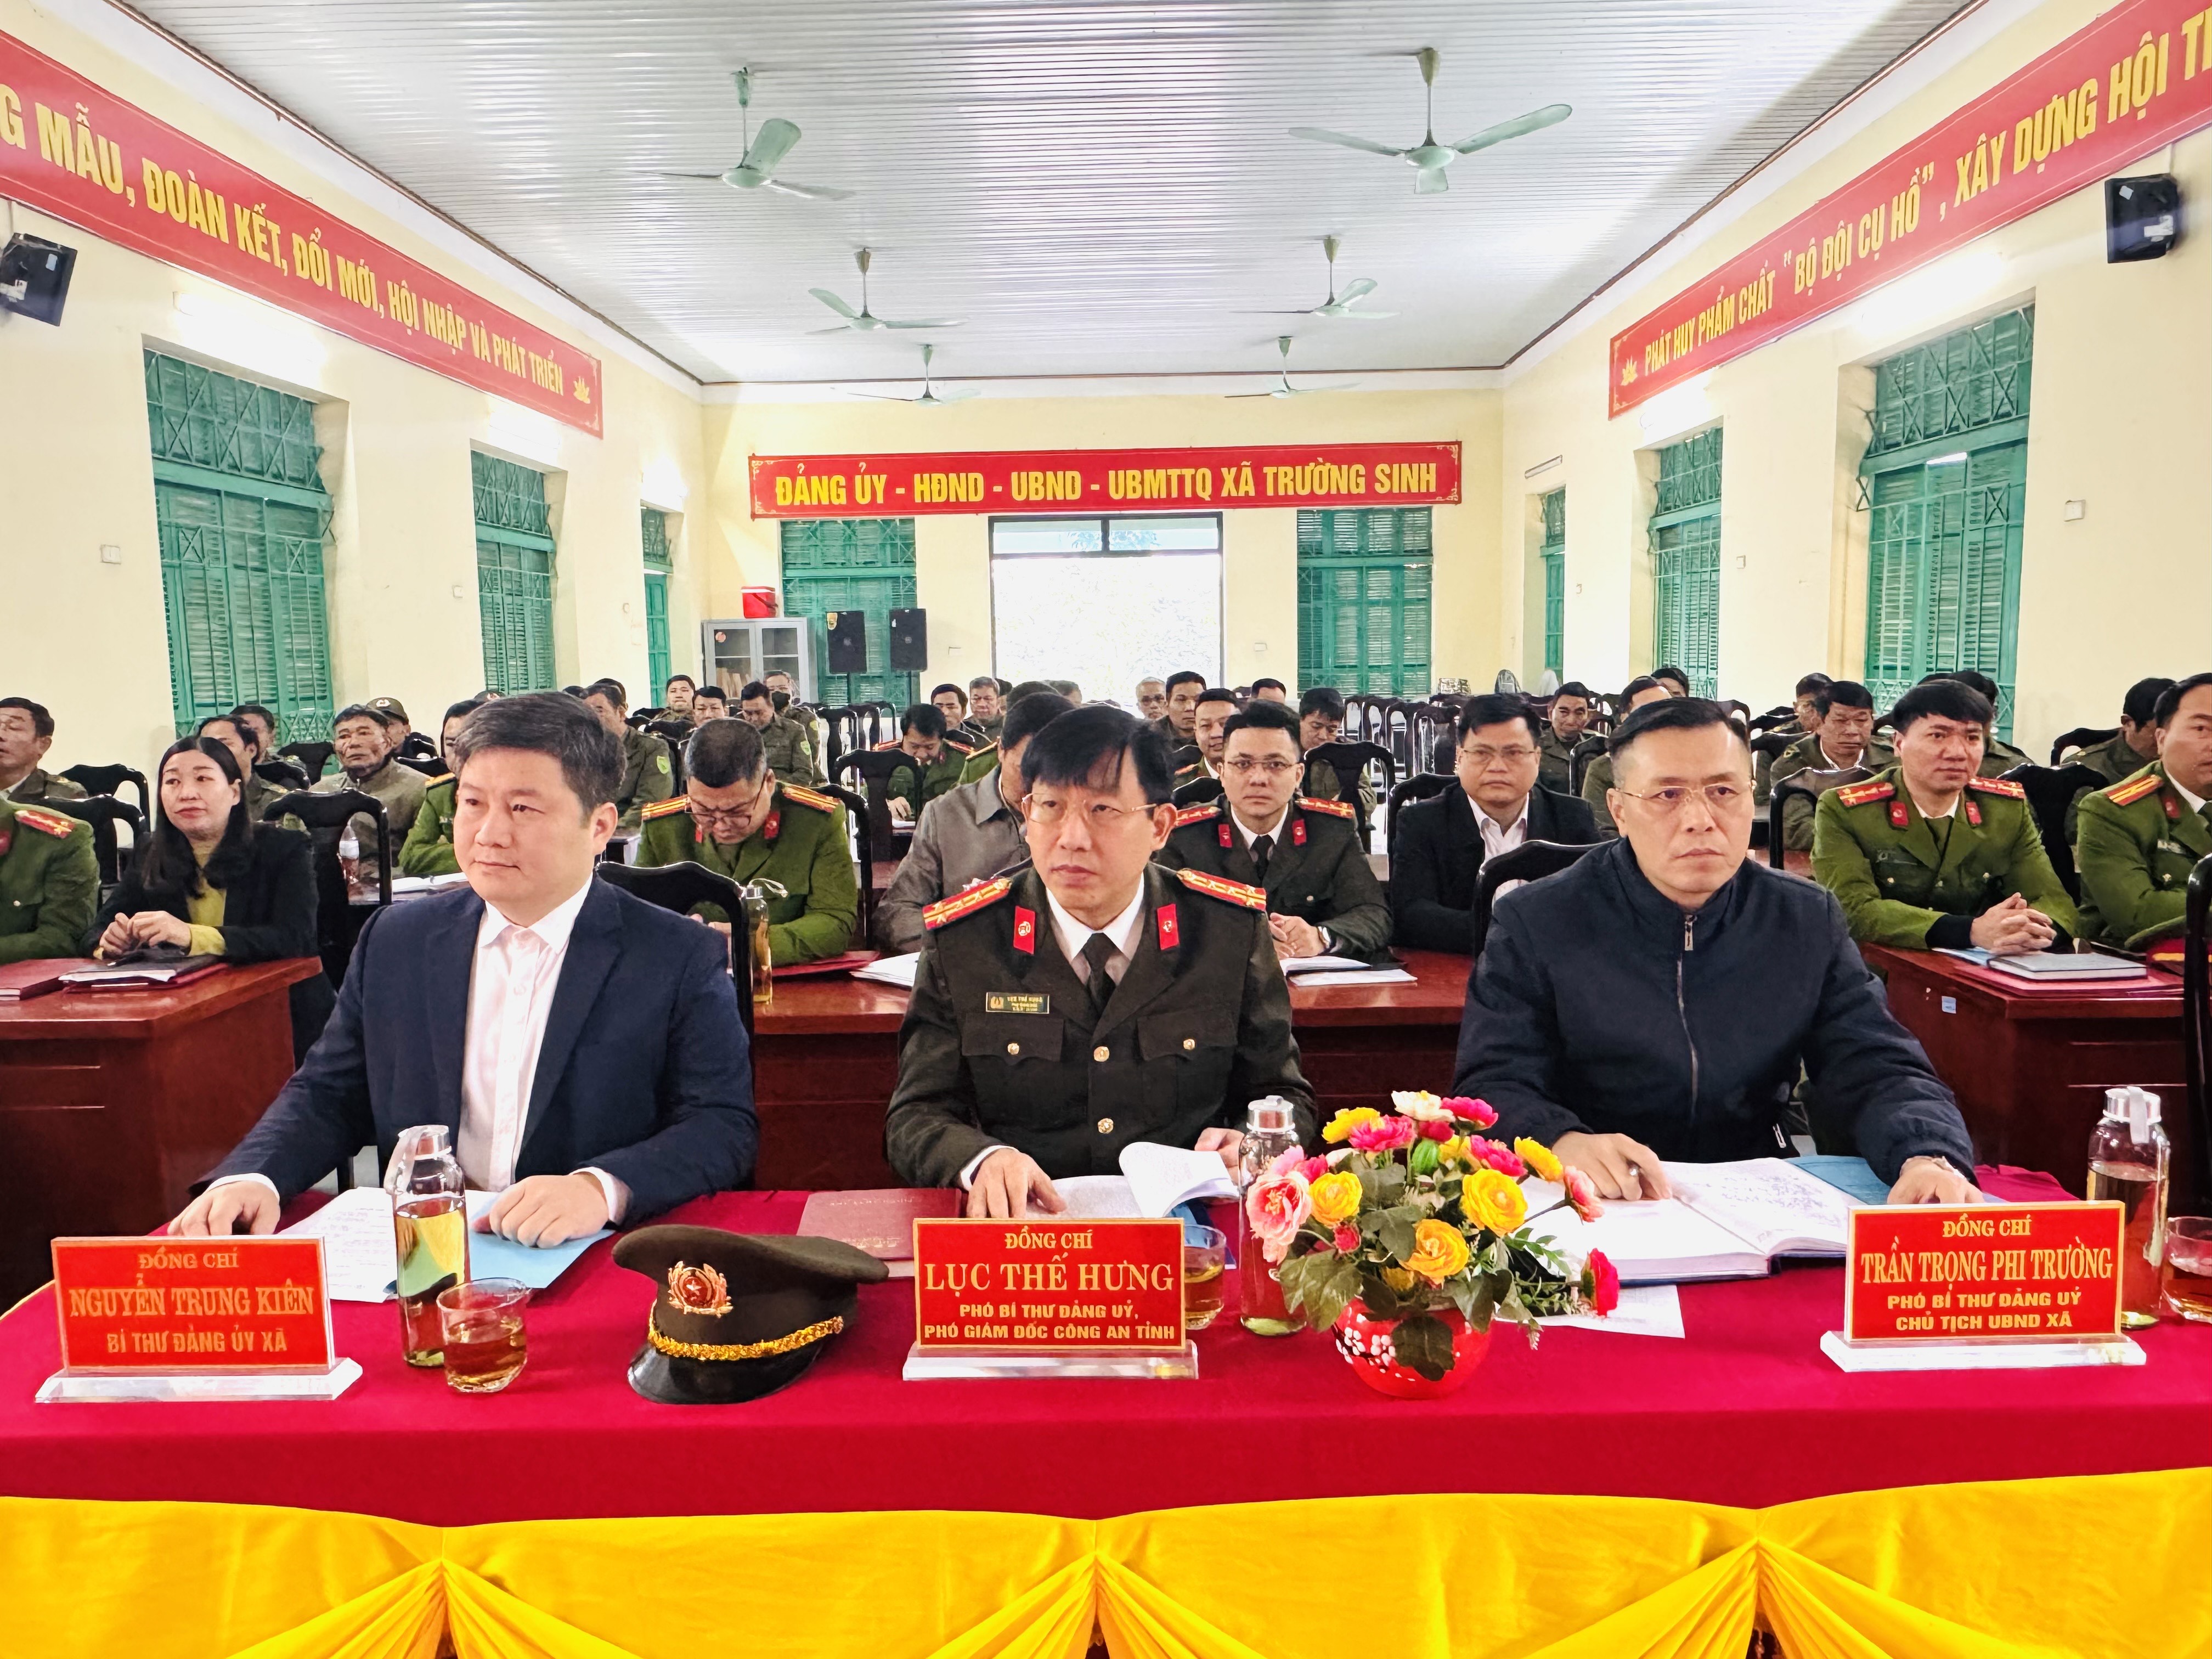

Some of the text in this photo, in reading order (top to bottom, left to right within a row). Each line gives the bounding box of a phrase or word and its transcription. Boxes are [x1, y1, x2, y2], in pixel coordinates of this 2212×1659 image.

[1645, 329, 1671, 376] PHÁT
[1673, 317, 1696, 360] HUY
[1698, 285, 1735, 347] PHẨM
[1739, 259, 1776, 324] CHẤT
[1821, 220, 1853, 281] ĐỘI
[1858, 203, 1886, 261] CỤ
[1953, 133, 2007, 208] XÂY
[2013, 78, 2098, 174] DỰNG
[2107, 31, 2169, 123] HỘI
[35, 102, 136, 207] MẪU,
[142, 157, 229, 244] ĐOÀN
[234, 202, 287, 276] KẾT,
[292, 227, 332, 291] ĐỔI
[336, 258, 385, 319] MỚI,
[387, 280, 420, 336] HỘI
[422, 303, 467, 355] NHẬP
[469, 320, 491, 363] VÀ
[492, 337, 527, 379] PHÁT
[528, 349, 564, 396] TRIỂN
[775, 463, 847, 506] ĐẢNG
[855, 462, 888, 504] ỦY
[914, 472, 984, 504] HĐND
[1011, 471, 1081, 501] UBND
[1108, 468, 1212, 501] UBMTTQ
[1221, 461, 1256, 497] XÃ
[1263, 457, 1366, 495] TRƯỜNG
[1374, 463, 1437, 493] SINH
[1005, 1225, 1093, 1249] ĐỒNG CHÍ
[1999, 1214, 2033, 1237] CHÍ
[203, 1246, 239, 1268] CHÍ
[1860, 1235, 2113, 1291] TRẦN TRỌNG PHI TRƯỜNG
[924, 1252, 1175, 1297] LỤC THẾ HƯNG
[69, 1273, 314, 1317] NGUYỄN TRUNG KIÊN
[960, 1301, 994, 1317] PHÓ
[999, 1301, 1016, 1318] BÍ
[1022, 1304, 1056, 1318] THƯ
[1059, 1299, 1107, 1318] ĐẢNG
[1887, 1286, 2082, 1310] PHÓ BÍ THƯ ĐẢNG UỶ
[924, 1321, 1175, 1339] PHÓ GIÁM ĐỐC CÔNG AN TỈNH
[1896, 1311, 2073, 1333] CHỦ TỊCH UBND XÃ
[107, 1328, 126, 1353] BÍ
[132, 1330, 170, 1353] THƯ
[172, 1323, 225, 1353] ĐẢNG
[261, 1328, 287, 1352] XÃ
